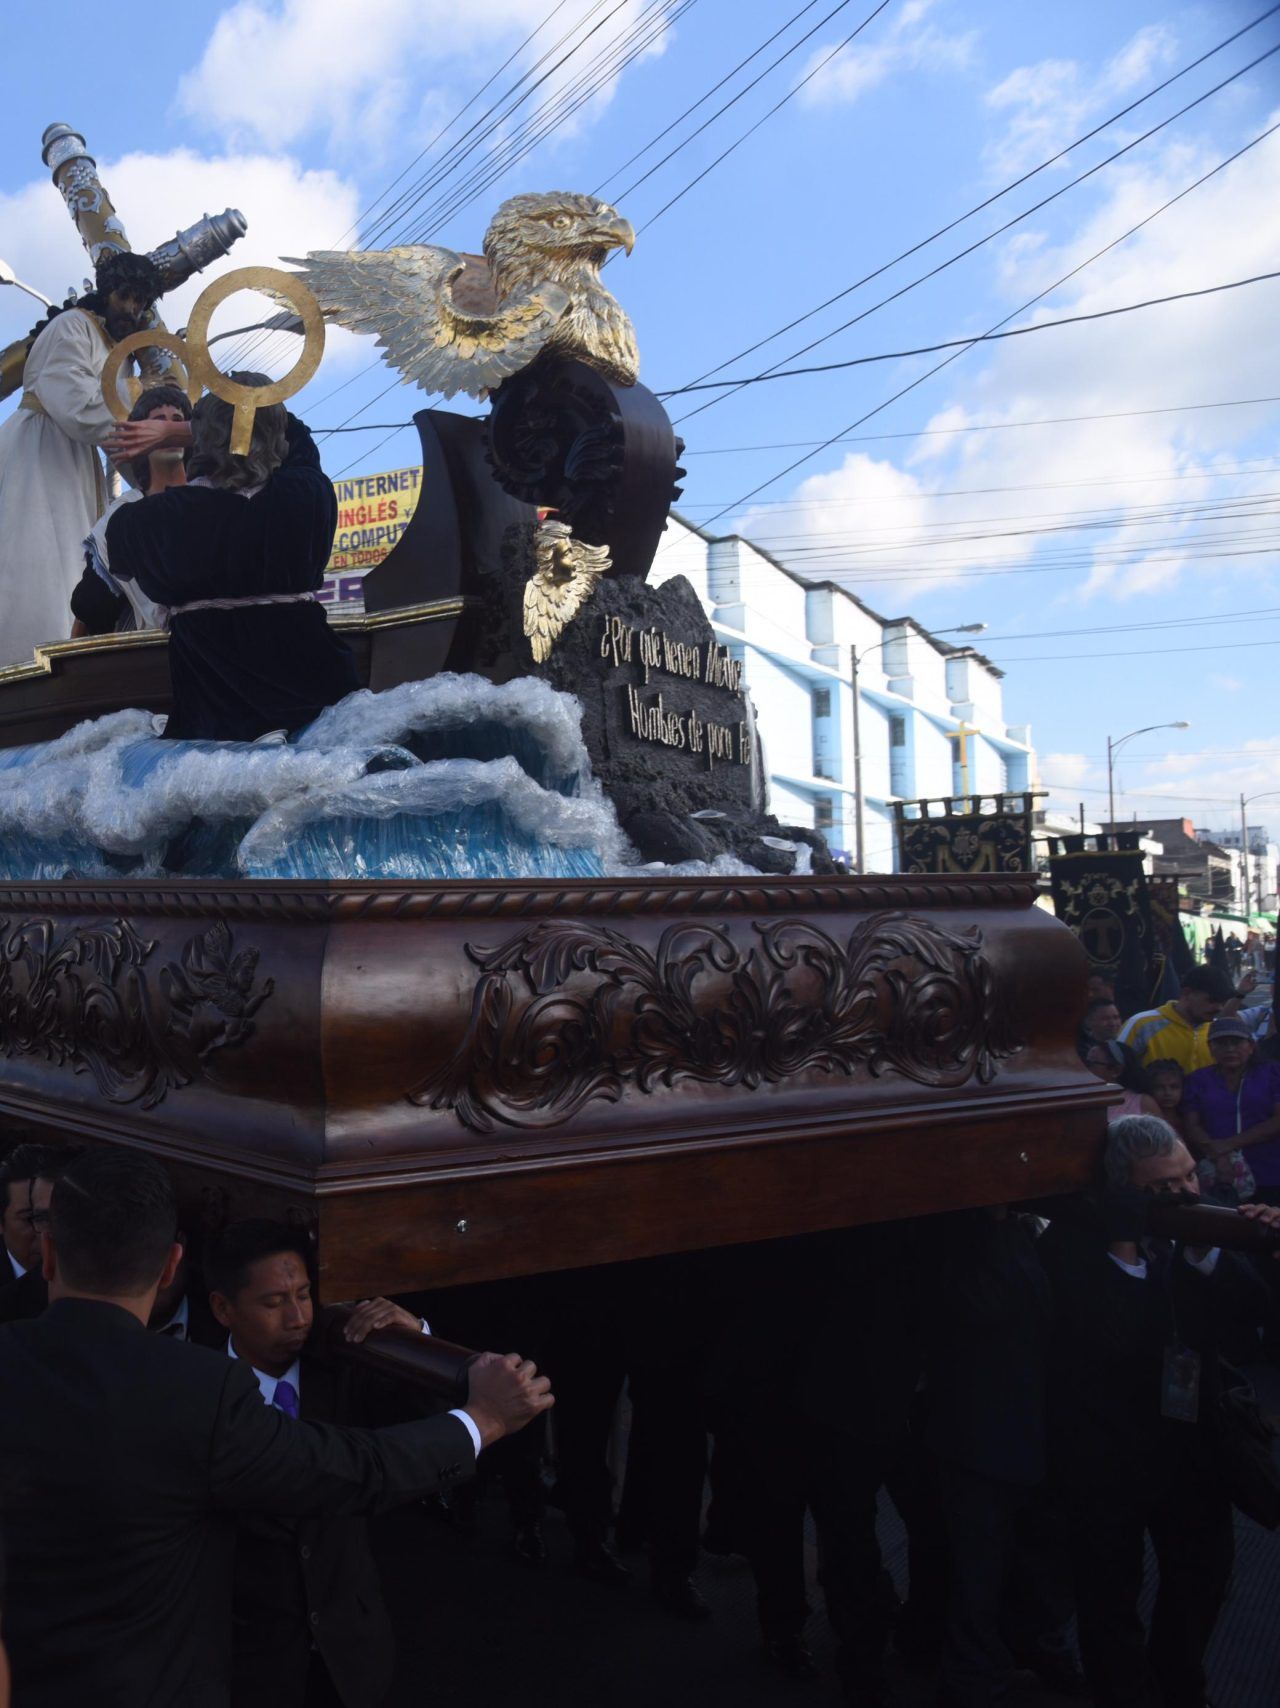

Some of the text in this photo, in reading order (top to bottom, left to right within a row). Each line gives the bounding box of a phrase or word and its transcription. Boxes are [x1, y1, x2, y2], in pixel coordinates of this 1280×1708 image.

[337, 469, 420, 502] INTERNET
[337, 497, 398, 529] INGLÉS
[333, 554, 347, 569] EN
[600, 613, 634, 667] ¿Por
[662, 631, 700, 679] tienen
[628, 683, 686, 749] Hombres
[688, 709, 703, 753] de
[707, 721, 733, 771] poco
